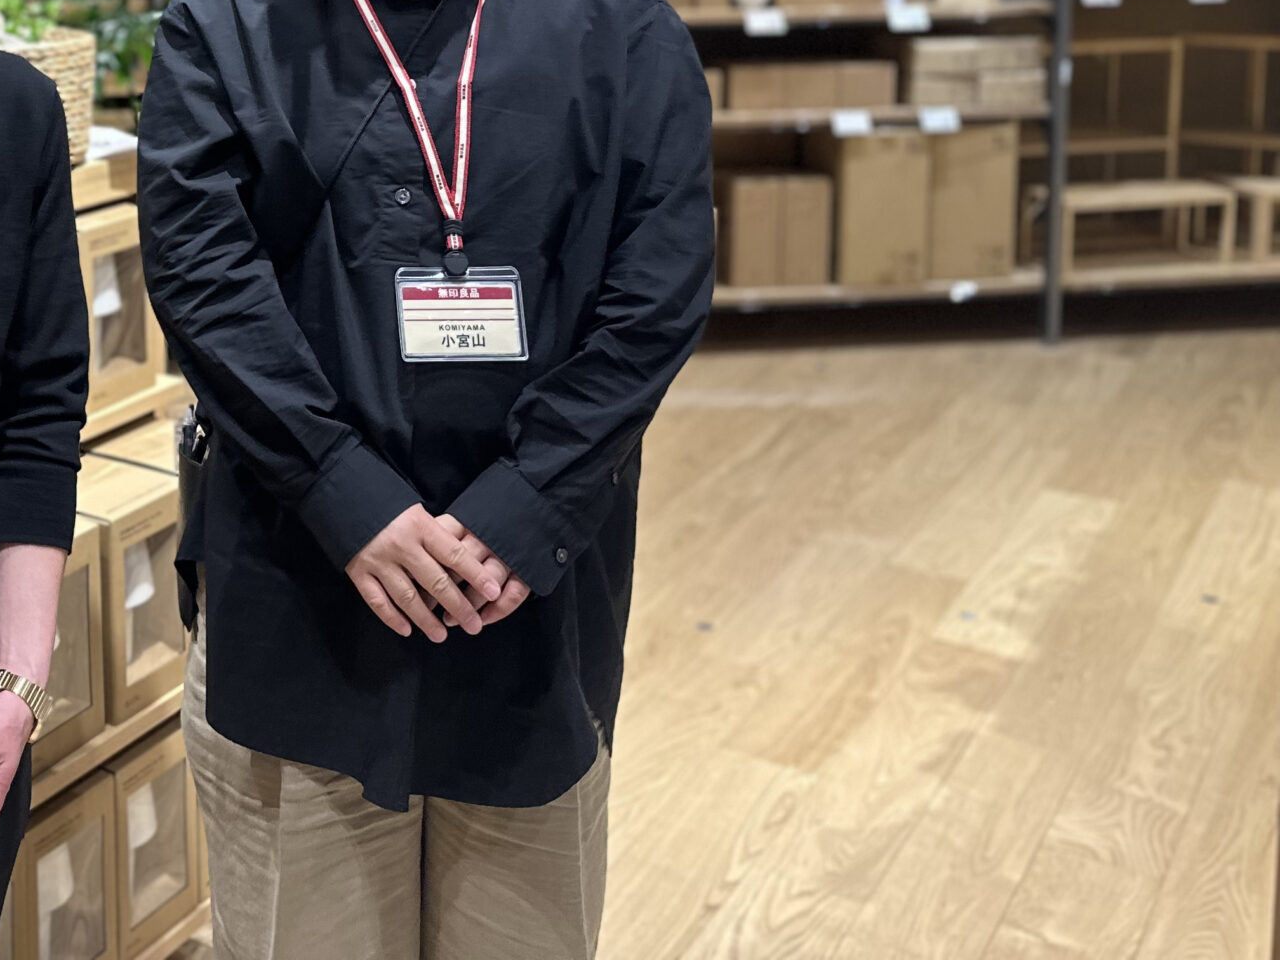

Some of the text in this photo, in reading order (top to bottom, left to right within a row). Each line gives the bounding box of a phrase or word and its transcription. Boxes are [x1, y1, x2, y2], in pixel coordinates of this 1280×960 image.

[438, 288, 480, 298] 無印良品
[441, 334, 486, 348] 小宮山
